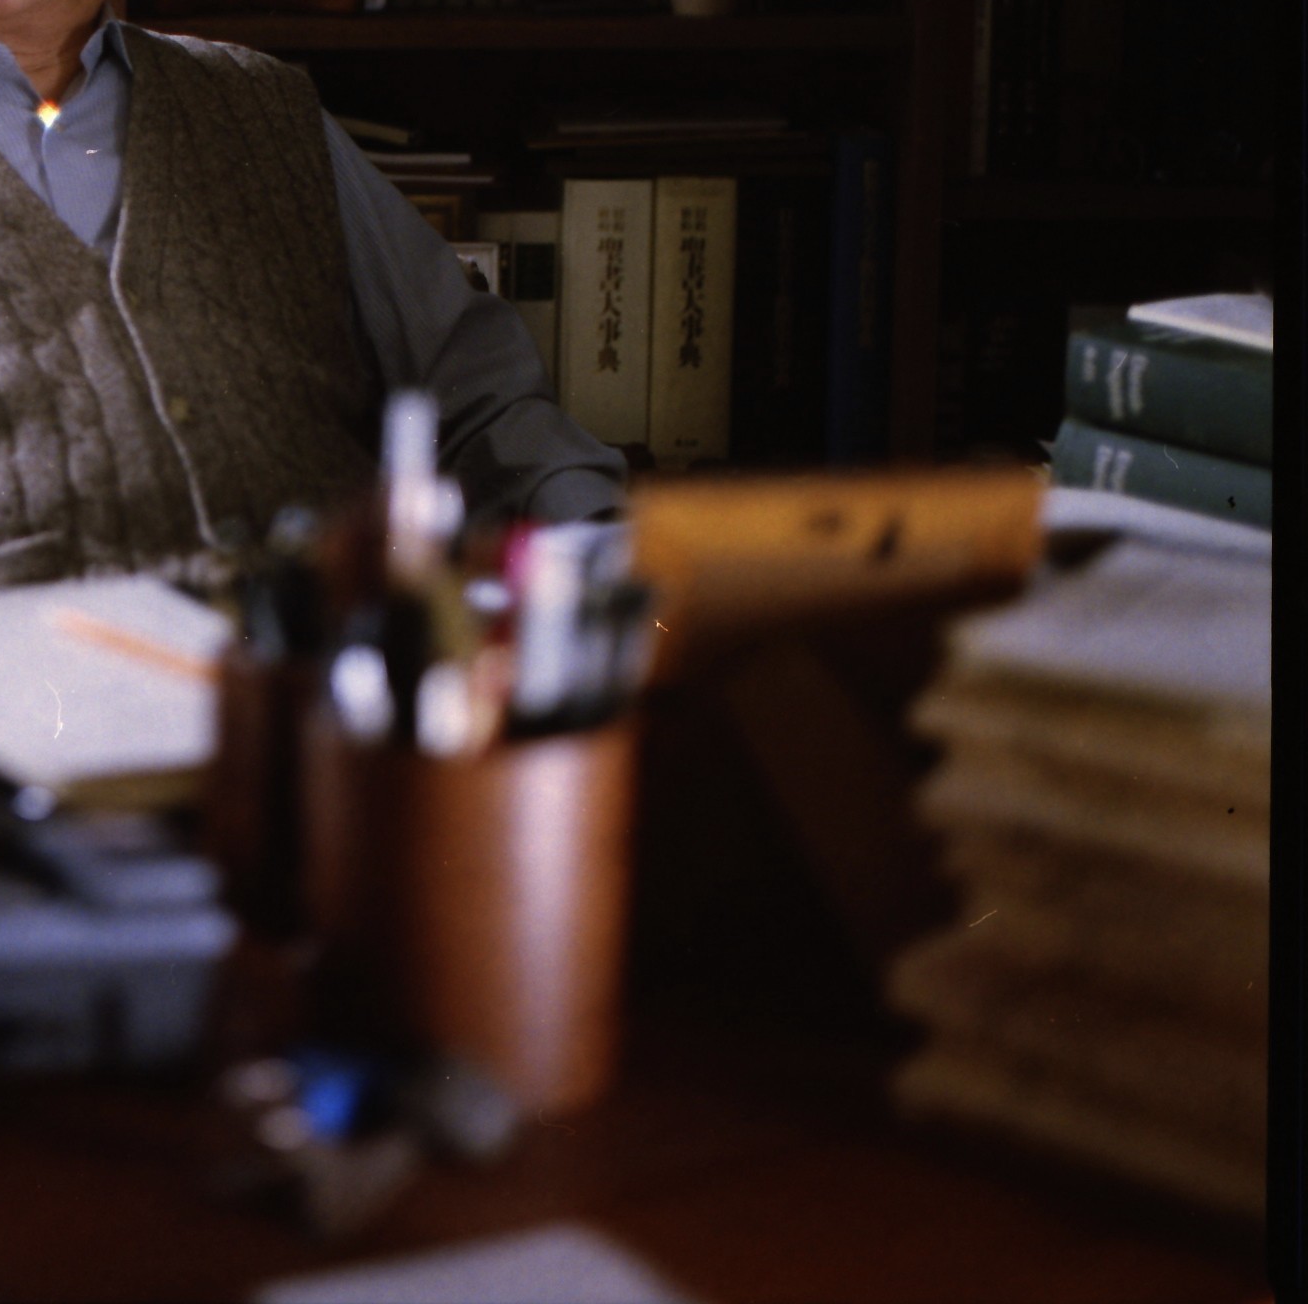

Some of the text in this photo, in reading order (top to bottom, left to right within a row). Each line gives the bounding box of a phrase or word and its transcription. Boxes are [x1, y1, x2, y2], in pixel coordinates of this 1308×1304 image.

[597, 237, 622, 372] 聖書大事典
[680, 237, 705, 369] 聖書大事典
